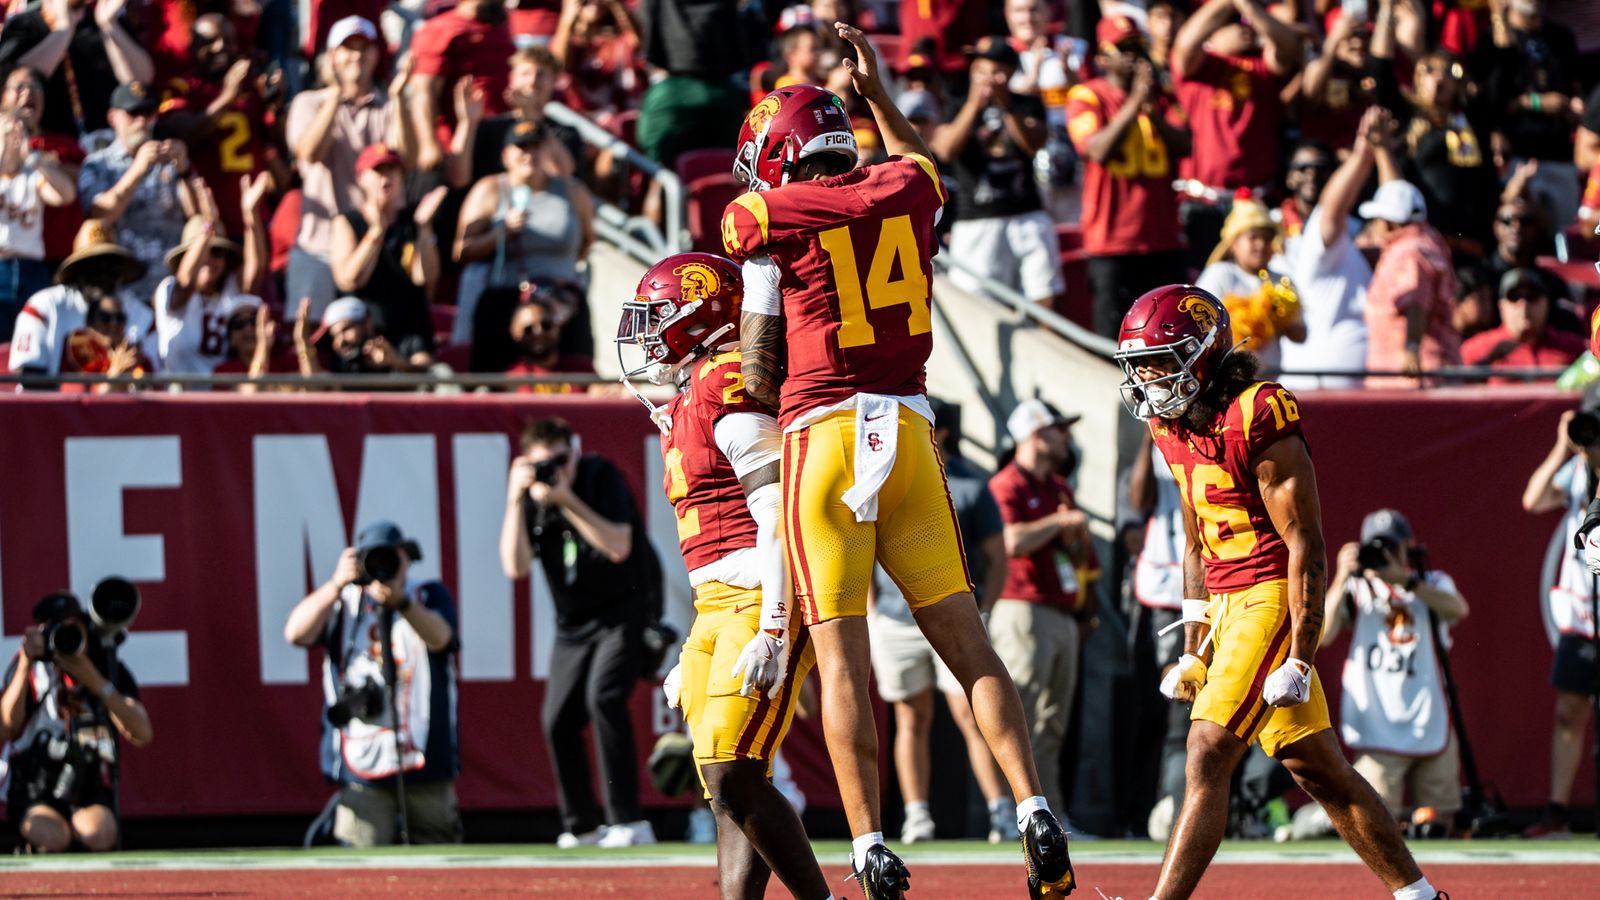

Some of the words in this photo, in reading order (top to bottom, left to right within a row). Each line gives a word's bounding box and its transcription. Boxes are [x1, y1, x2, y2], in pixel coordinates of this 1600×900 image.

[220, 111, 253, 170] 2
[825, 134, 851, 146] FIGHT
[818, 214, 932, 349] 14
[723, 371, 745, 405] 2
[1265, 388, 1300, 430] 16
[1170, 464, 1258, 560] 16
